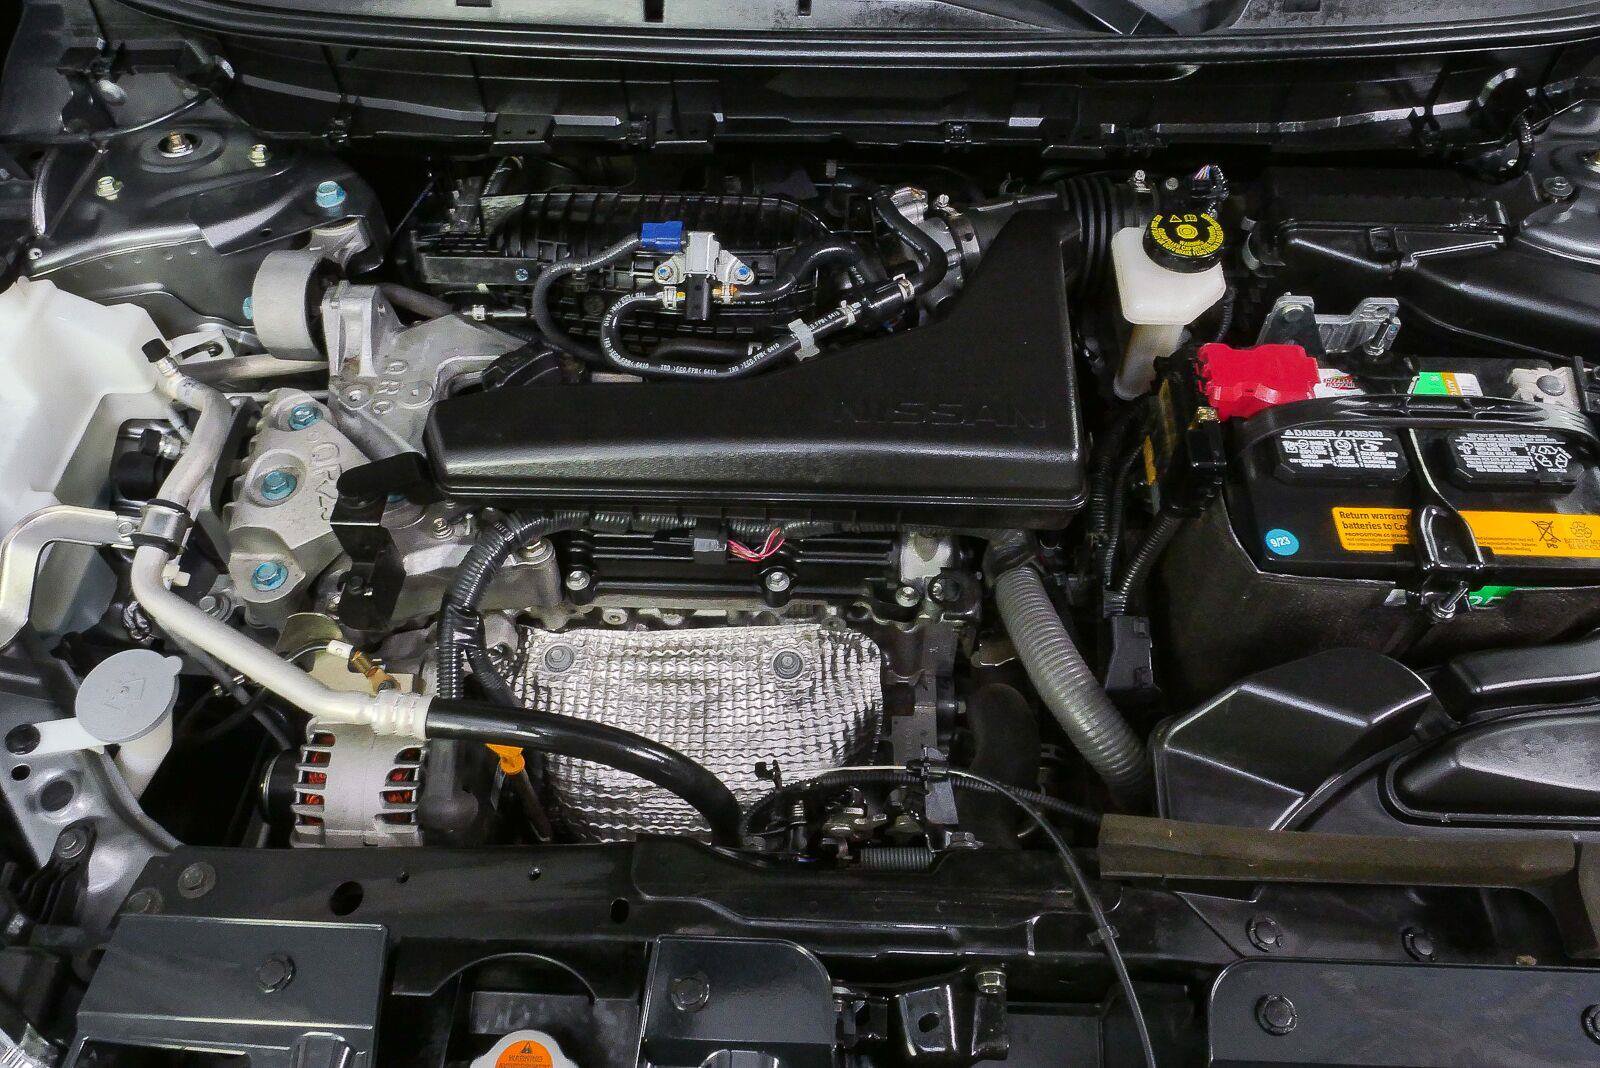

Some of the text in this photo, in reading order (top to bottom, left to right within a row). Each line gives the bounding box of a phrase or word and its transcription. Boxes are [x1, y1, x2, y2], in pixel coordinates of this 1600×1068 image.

[832, 402, 1047, 428] NISSAN
[1294, 429, 1336, 437] DANGER
[1345, 430, 1384, 438] POISON
[1339, 511, 1370, 519] Return
[1342, 521, 1382, 530] batteries
[1270, 536, 1291, 548] 9/23
